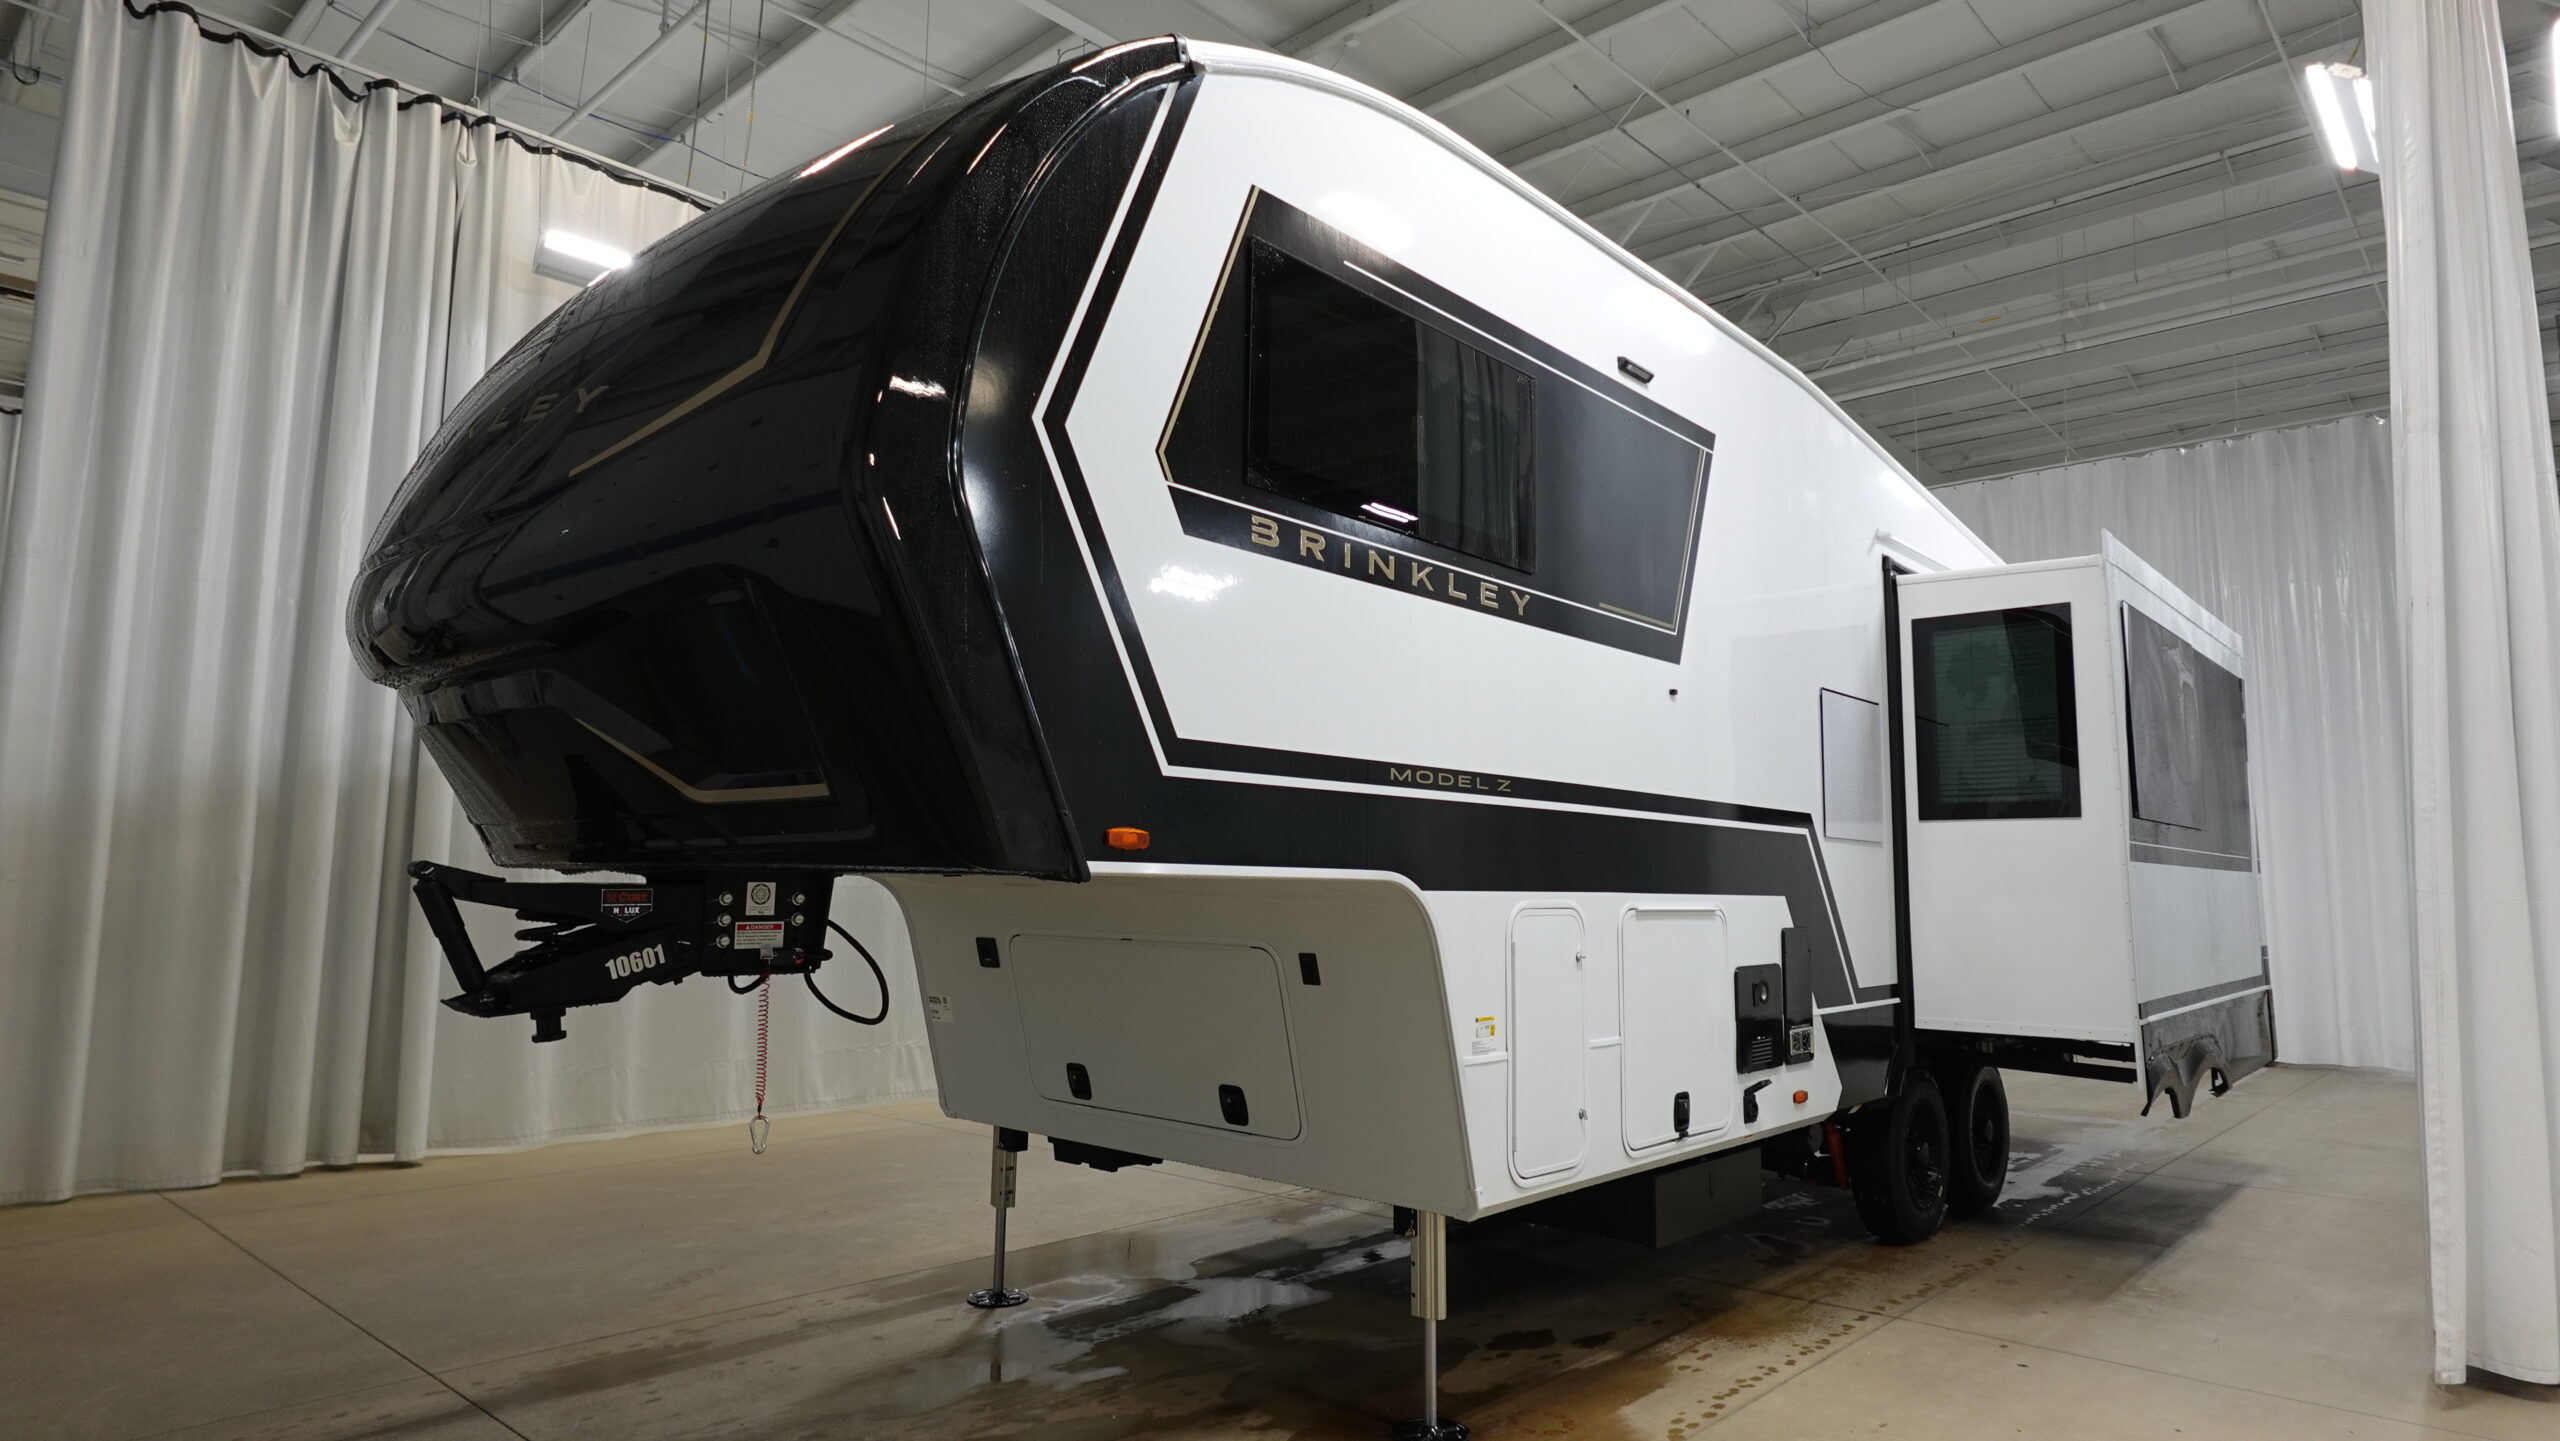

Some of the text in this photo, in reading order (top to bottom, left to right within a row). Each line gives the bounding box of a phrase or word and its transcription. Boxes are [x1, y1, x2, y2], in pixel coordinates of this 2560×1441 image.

[1250, 513, 1531, 616] BRINKLEY
[1390, 767, 1512, 792] MODEL Z
[604, 943, 666, 980] 10601
